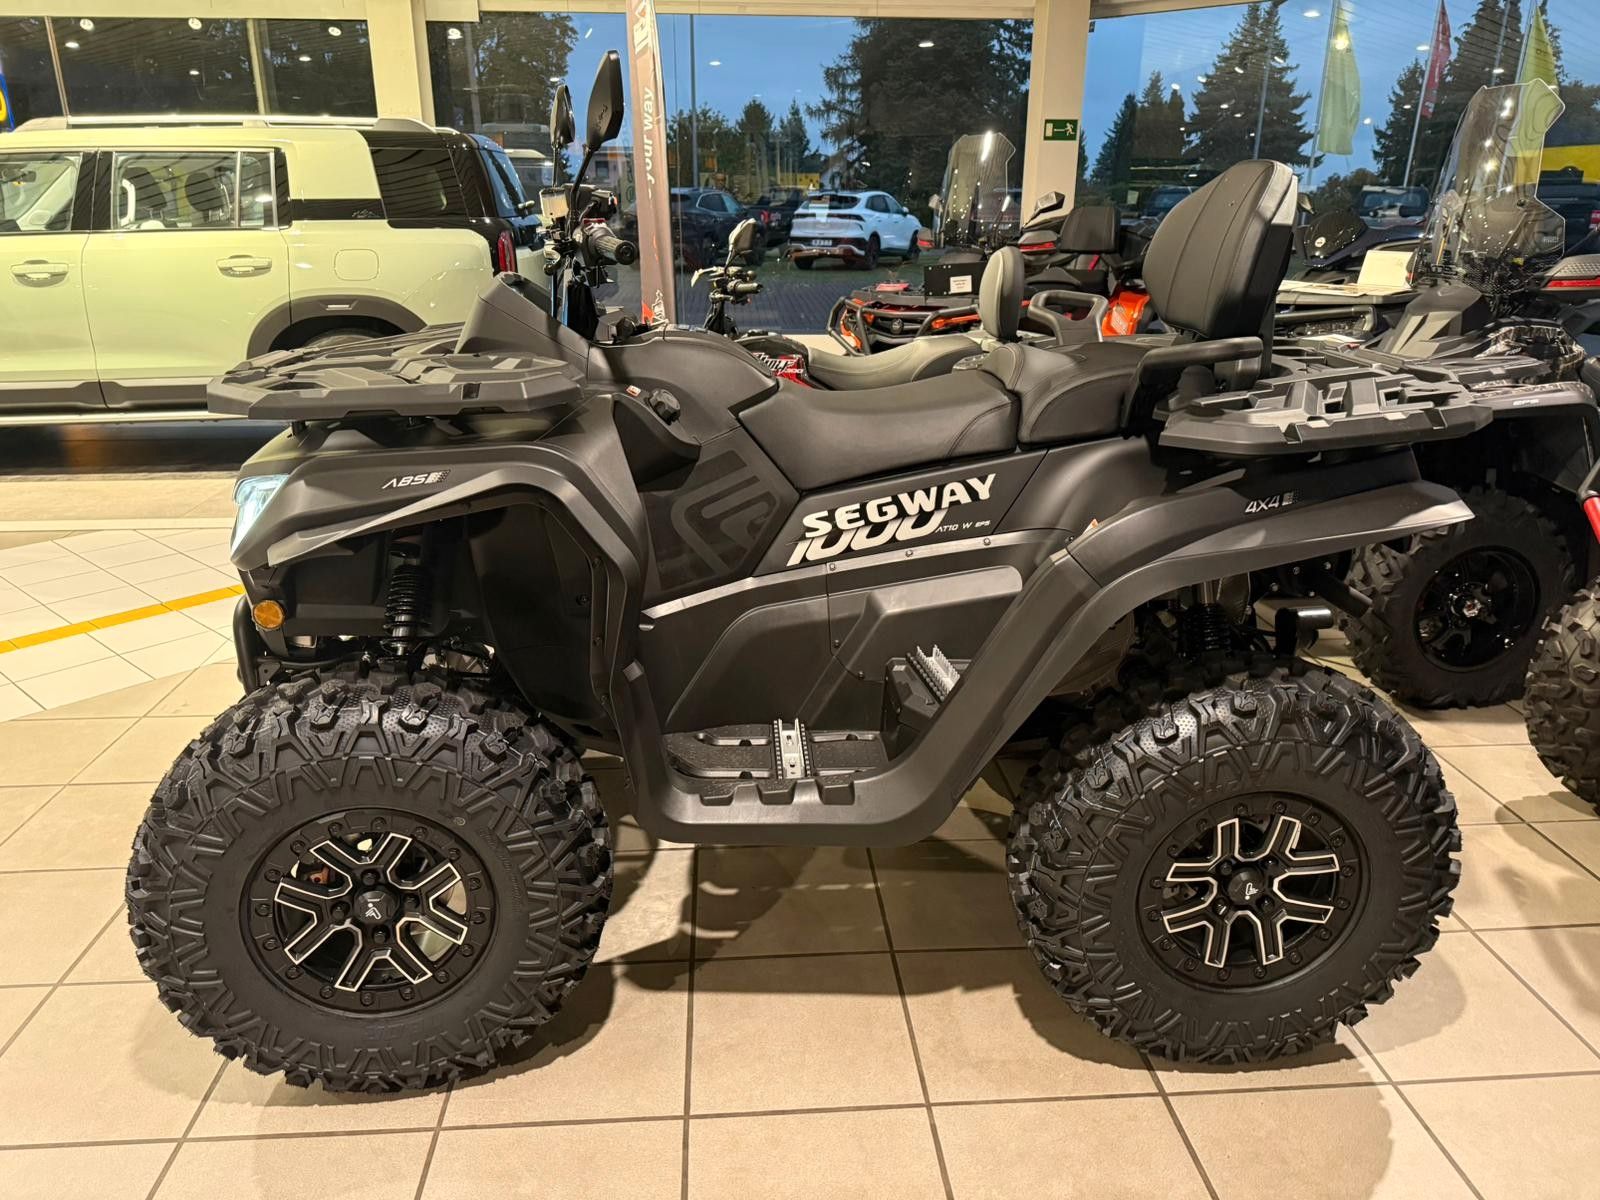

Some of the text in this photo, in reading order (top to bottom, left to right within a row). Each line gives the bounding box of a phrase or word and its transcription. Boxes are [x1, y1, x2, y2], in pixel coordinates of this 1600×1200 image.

[642, 87, 656, 129] way
[381, 473, 429, 489] ABS
[802, 473, 996, 538] SEGWAY
[785, 509, 948, 567] 1000
[962, 521, 973, 530] W
